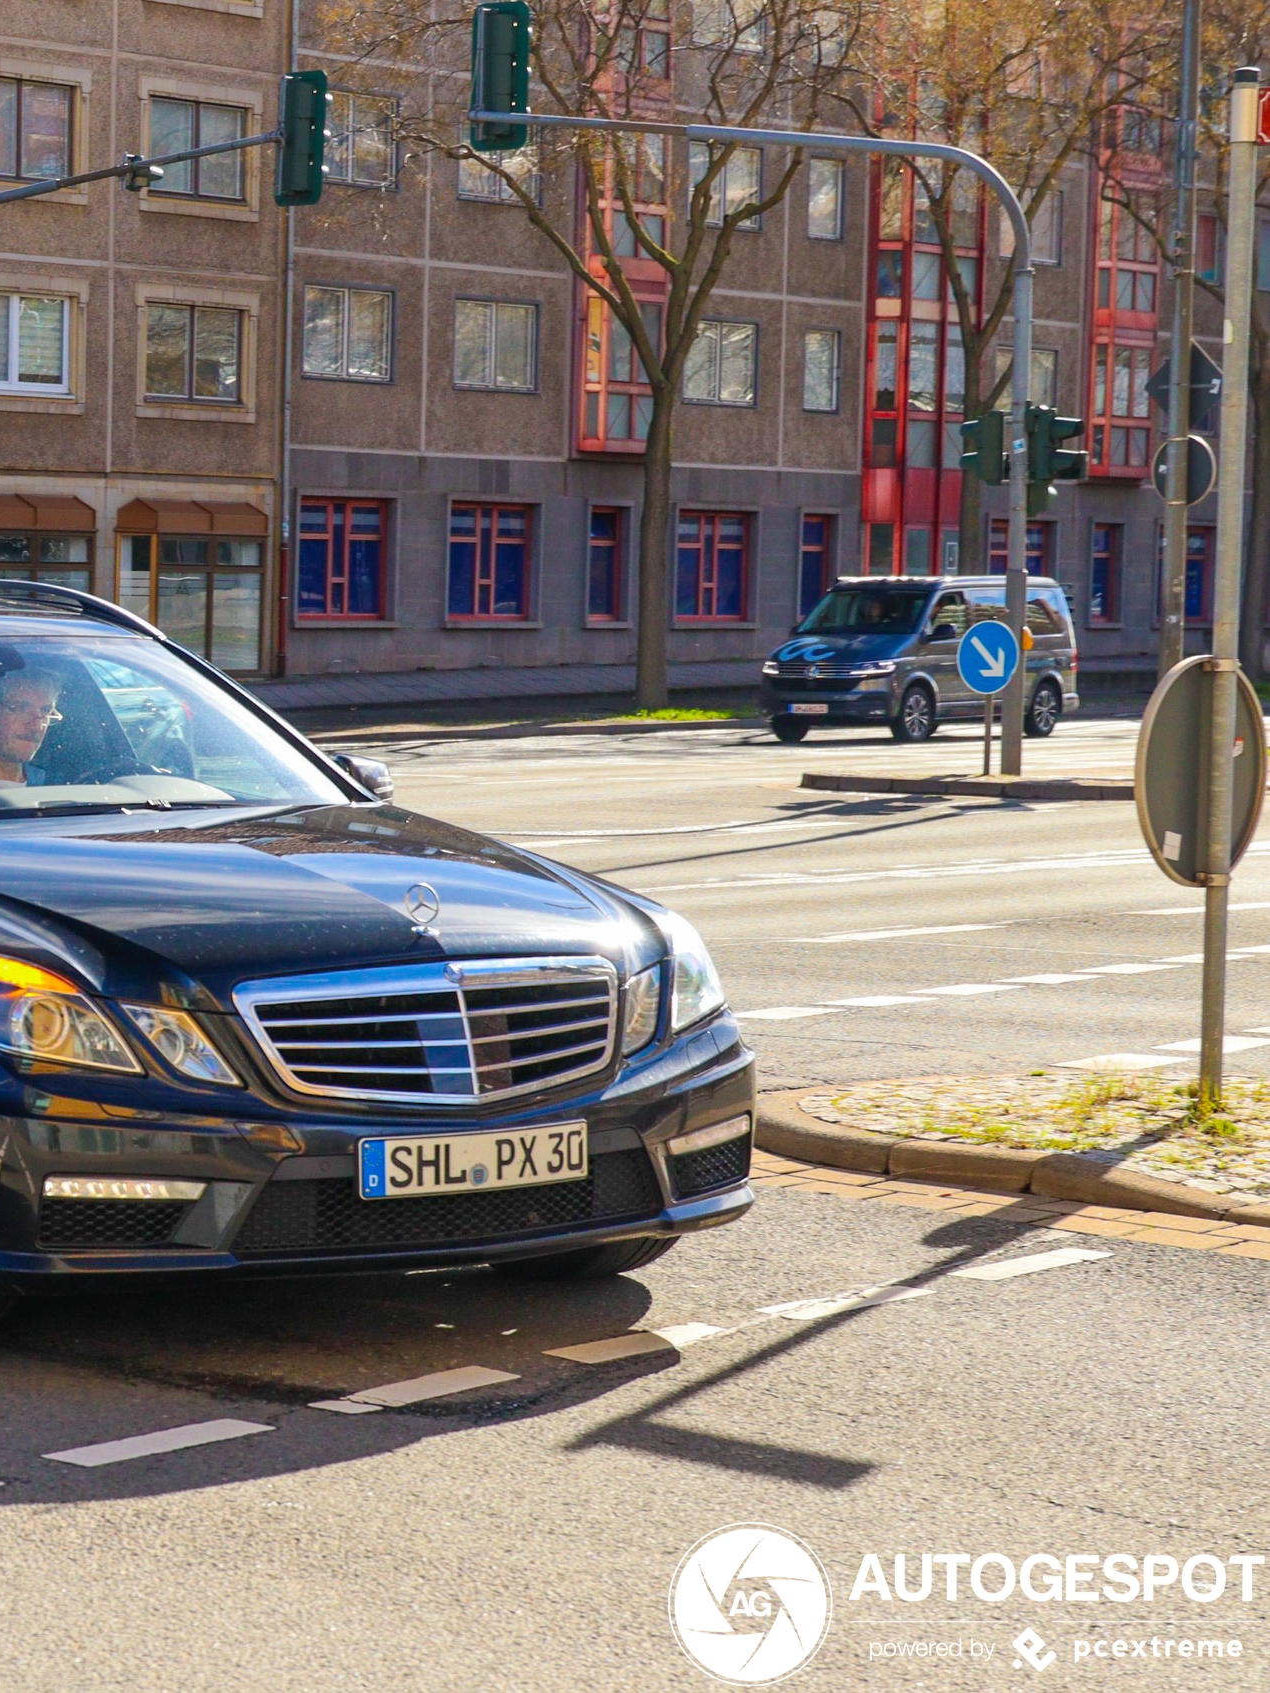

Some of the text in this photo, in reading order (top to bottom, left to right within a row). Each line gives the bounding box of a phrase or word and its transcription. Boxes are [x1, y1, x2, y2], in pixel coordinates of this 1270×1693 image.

[389, 1130, 584, 1188] SHL PX 30
[368, 1174, 379, 1188] D
